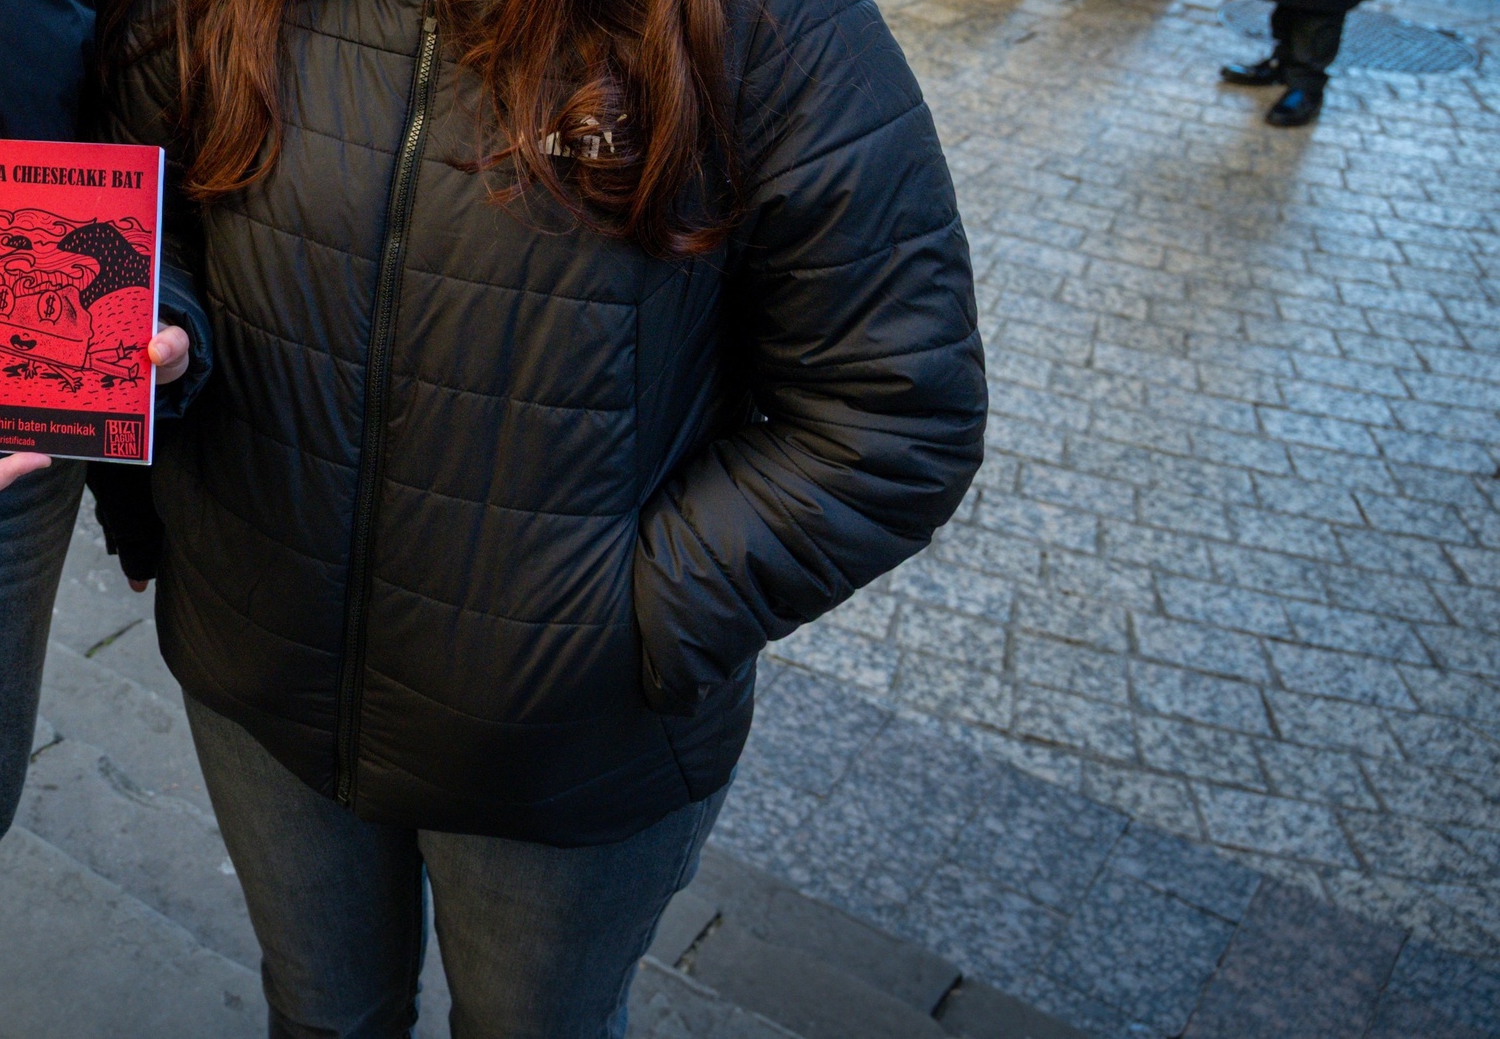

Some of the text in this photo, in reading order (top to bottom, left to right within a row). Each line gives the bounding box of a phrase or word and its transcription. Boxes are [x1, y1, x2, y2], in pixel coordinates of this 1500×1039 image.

[12, 165, 107, 187] CHEESECAKE
[111, 170, 144, 189] BAT
[18, 420, 47, 433] baten
[50, 421, 96, 436] kronikak
[110, 420, 135, 435] BIZI
[110, 433, 136, 444] LAGUN
[110, 442, 137, 456] EKIN
